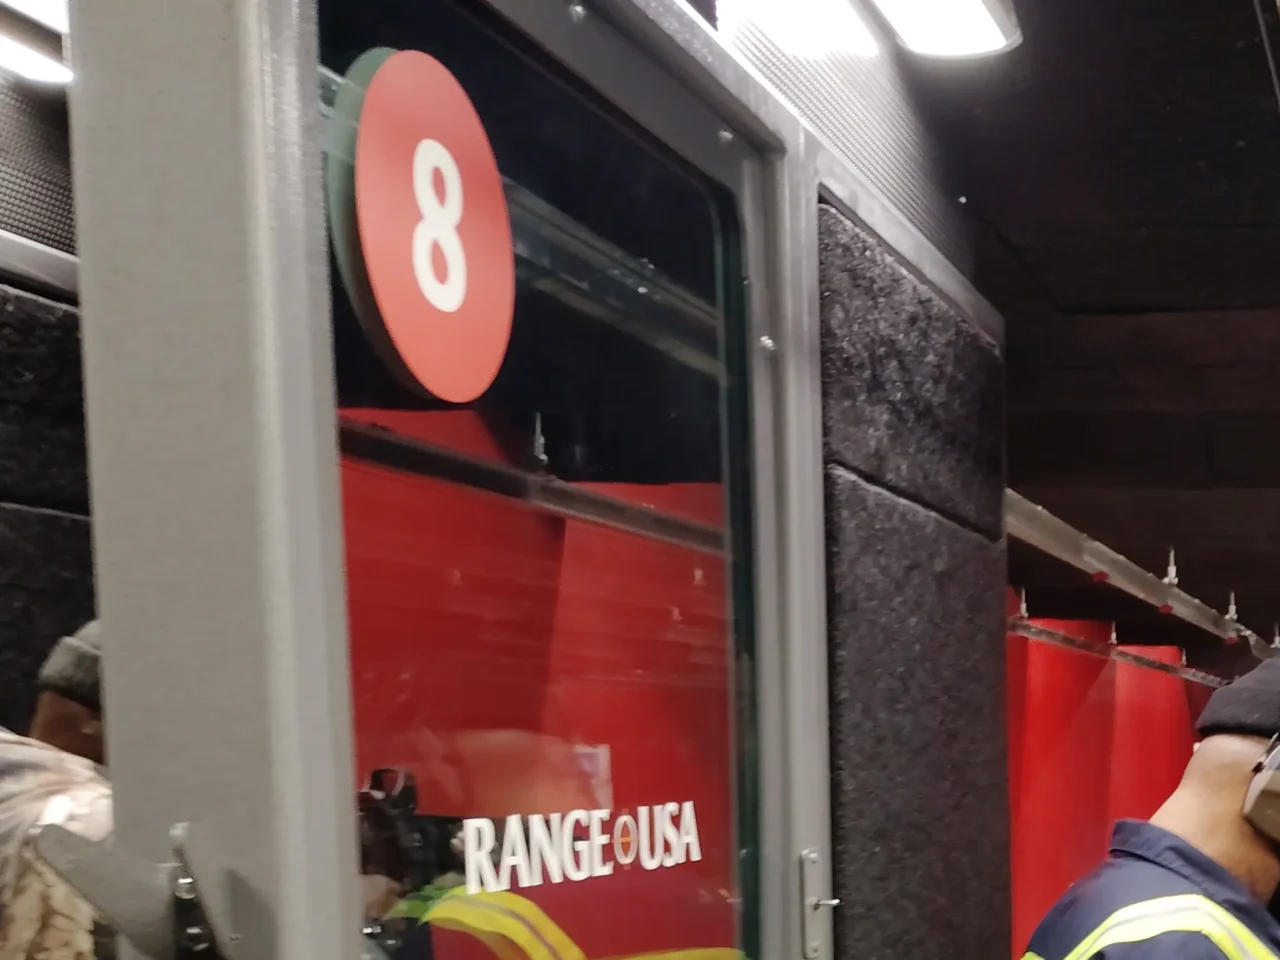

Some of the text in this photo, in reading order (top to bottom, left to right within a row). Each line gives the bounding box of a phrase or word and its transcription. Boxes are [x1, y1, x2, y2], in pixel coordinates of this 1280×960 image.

[413, 138, 467, 312] 8
[463, 800, 702, 895] RANGE USA
